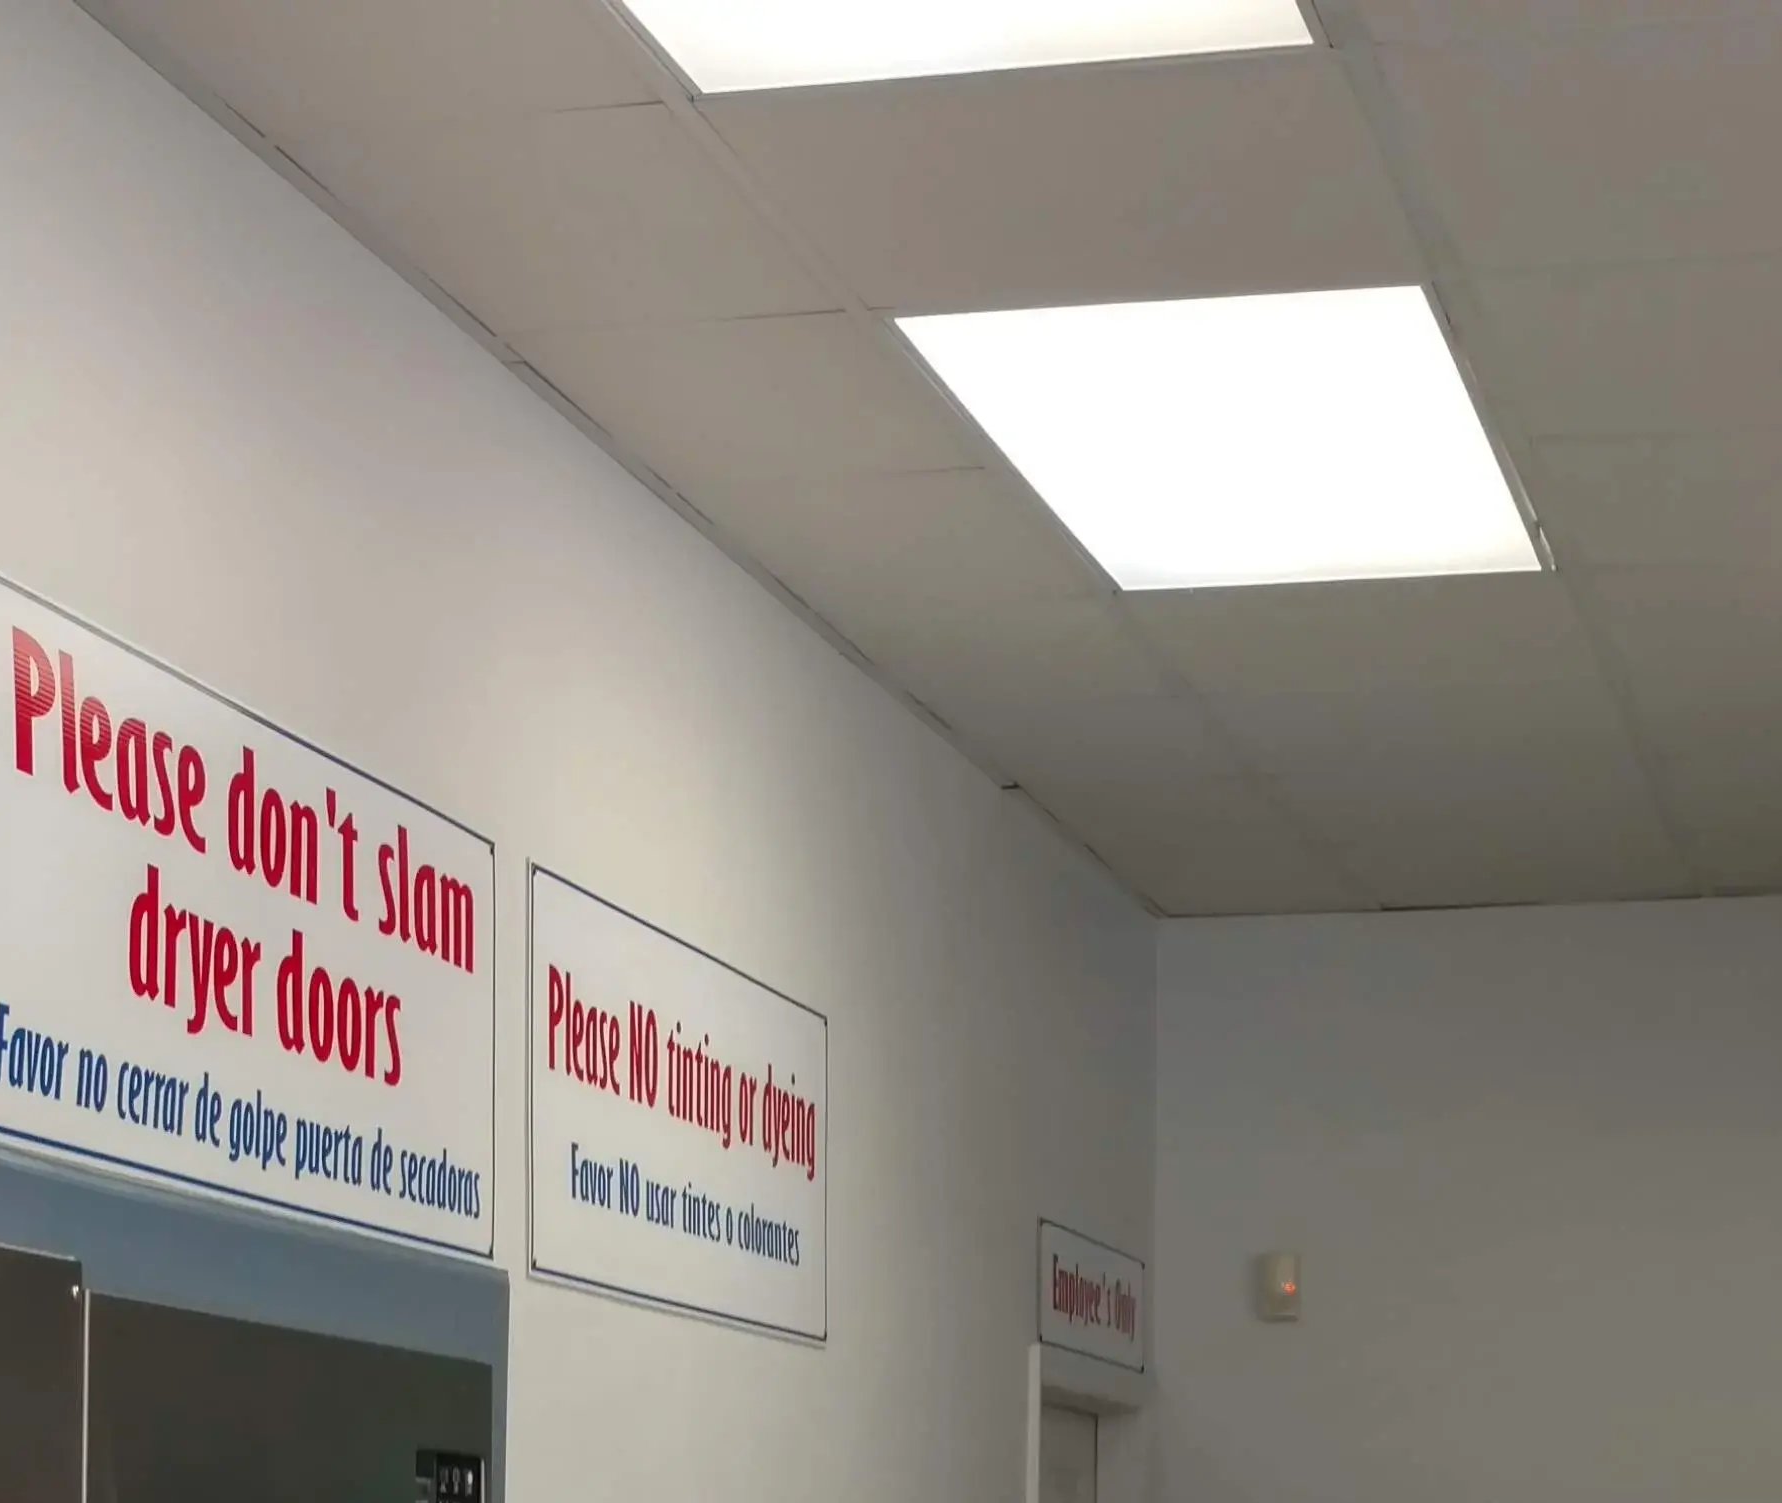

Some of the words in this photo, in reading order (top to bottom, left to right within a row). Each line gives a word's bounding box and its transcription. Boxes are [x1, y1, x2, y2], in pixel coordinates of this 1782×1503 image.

[11, 627, 208, 856] Please
[226, 746, 361, 924] don't
[377, 825, 475, 974] slam
[127, 864, 263, 1038] dryer
[275, 929, 403, 1088] doors
[548, 964, 620, 1096] Please
[629, 1000, 659, 1108] NO
[667, 1020, 731, 1149] tinting
[739, 1070, 757, 1146] or
[762, 1063, 816, 1181] dyeing
[77, 1048, 107, 1112] no
[118, 1060, 189, 1136] cerrar
[195, 1072, 222, 1147] de
[229, 1089, 287, 1171] golpe
[295, 1117, 363, 1185] puerta
[370, 1128, 392, 1193] de
[400, 1149, 481, 1220] secadoras
[570, 1141, 614, 1209] Favor
[619, 1157, 640, 1216] NO
[645, 1175, 677, 1229] usar
[681, 1180, 721, 1242] tintes
[725, 1207, 734, 1246] o
[738, 1203, 801, 1267] colorantes
[1052, 1252, 1111, 1329] Employee's
[1114, 1276, 1137, 1344] Only
